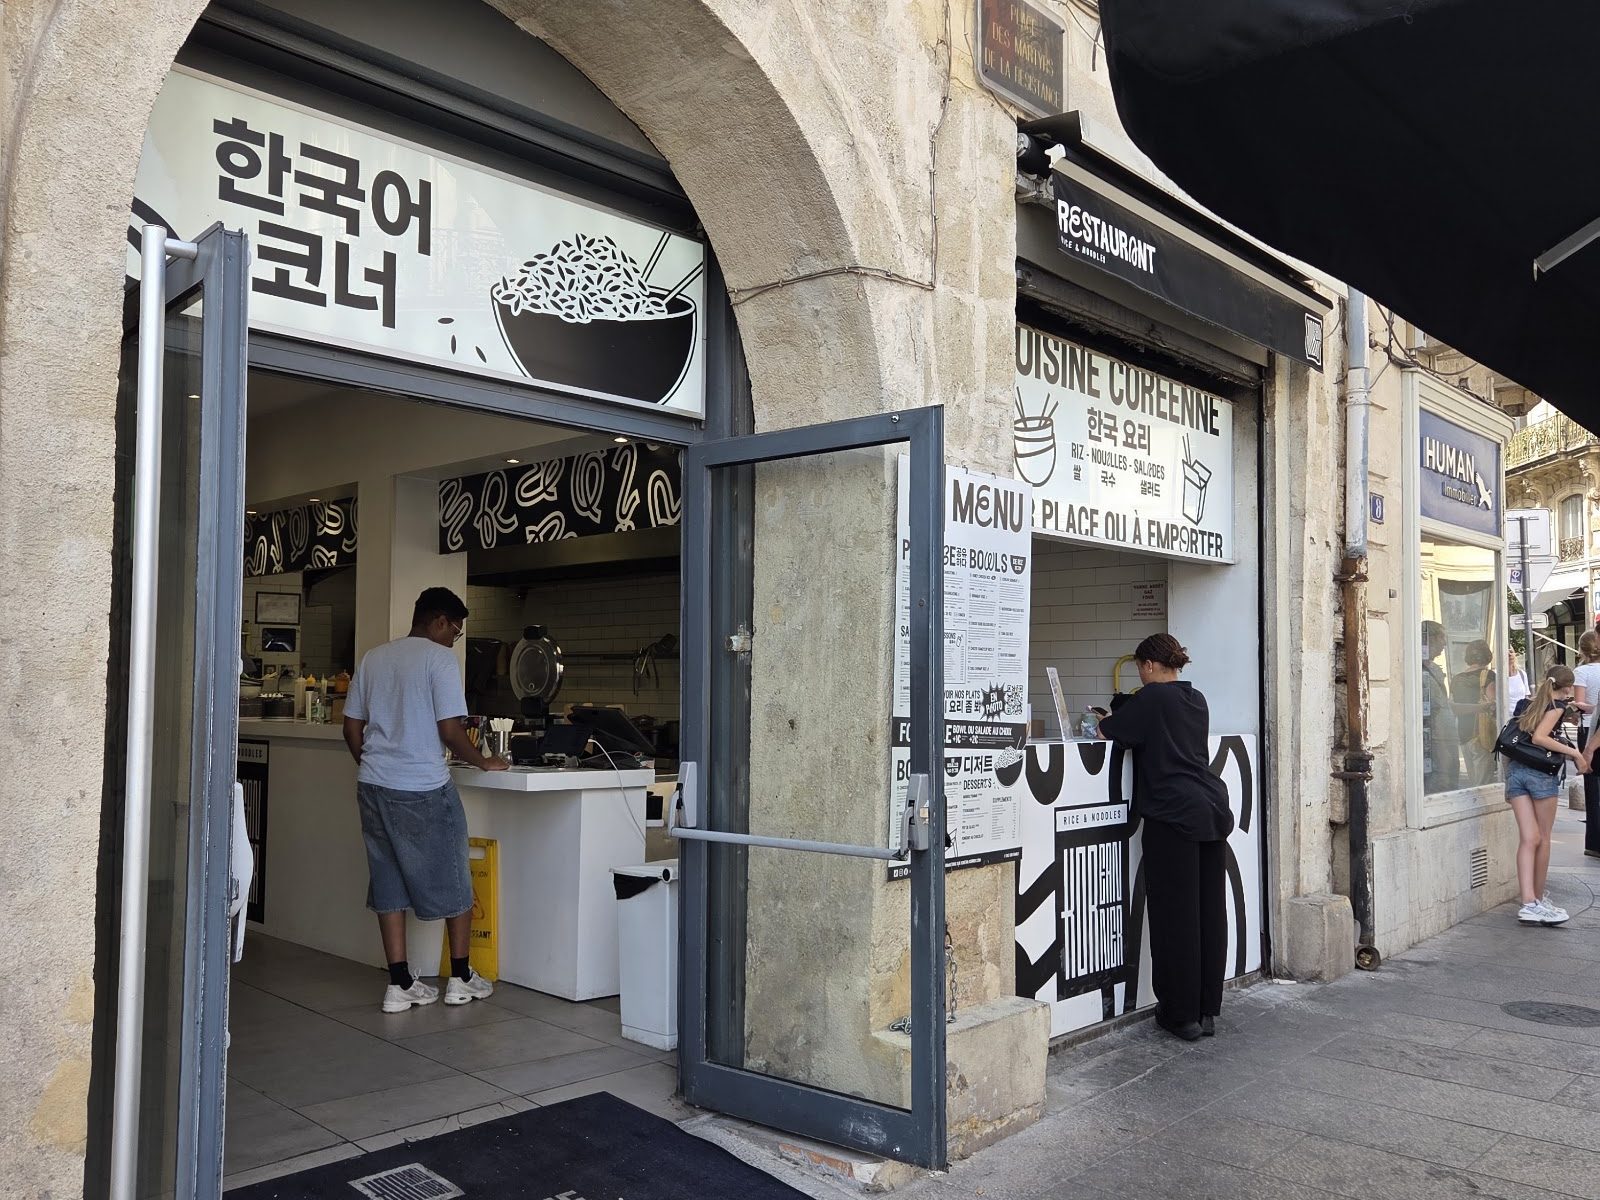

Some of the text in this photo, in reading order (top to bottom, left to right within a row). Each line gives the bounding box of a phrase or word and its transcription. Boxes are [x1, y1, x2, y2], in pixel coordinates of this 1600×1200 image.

[1010, 4, 1035, 36] PLACE
[984, 47, 995, 69] DE
[1000, 56, 1011, 79] LA
[992, 22, 1054, 77] DES MARTYRS
[213, 116, 431, 257] 한국어
[251, 219, 396, 329] 코너
[1087, 407, 1151, 456] 한국 요리
[1071, 442, 1084, 461] RIZ
[1424, 436, 1475, 485] HUMAN
[1073, 464, 1082, 482] 쌀
[1100, 470, 1116, 488] 국수
[952, 479, 1024, 533] MENU
[1375, 498, 1382, 519] 8
[1042, 498, 1099, 538] PLACE
[1104, 510, 1127, 543] OU
[1132, 509, 1143, 545] À
[1148, 520, 1224, 559] EMPORTER
[949, 700, 964, 714] 요리
[955, 690, 965, 699] NOS
[965, 690, 981, 699] PLATS
[240, 748, 262, 758] OODLES
[964, 755, 992, 774] 디저트
[1063, 809, 1122, 826] RICE & NOODLES
